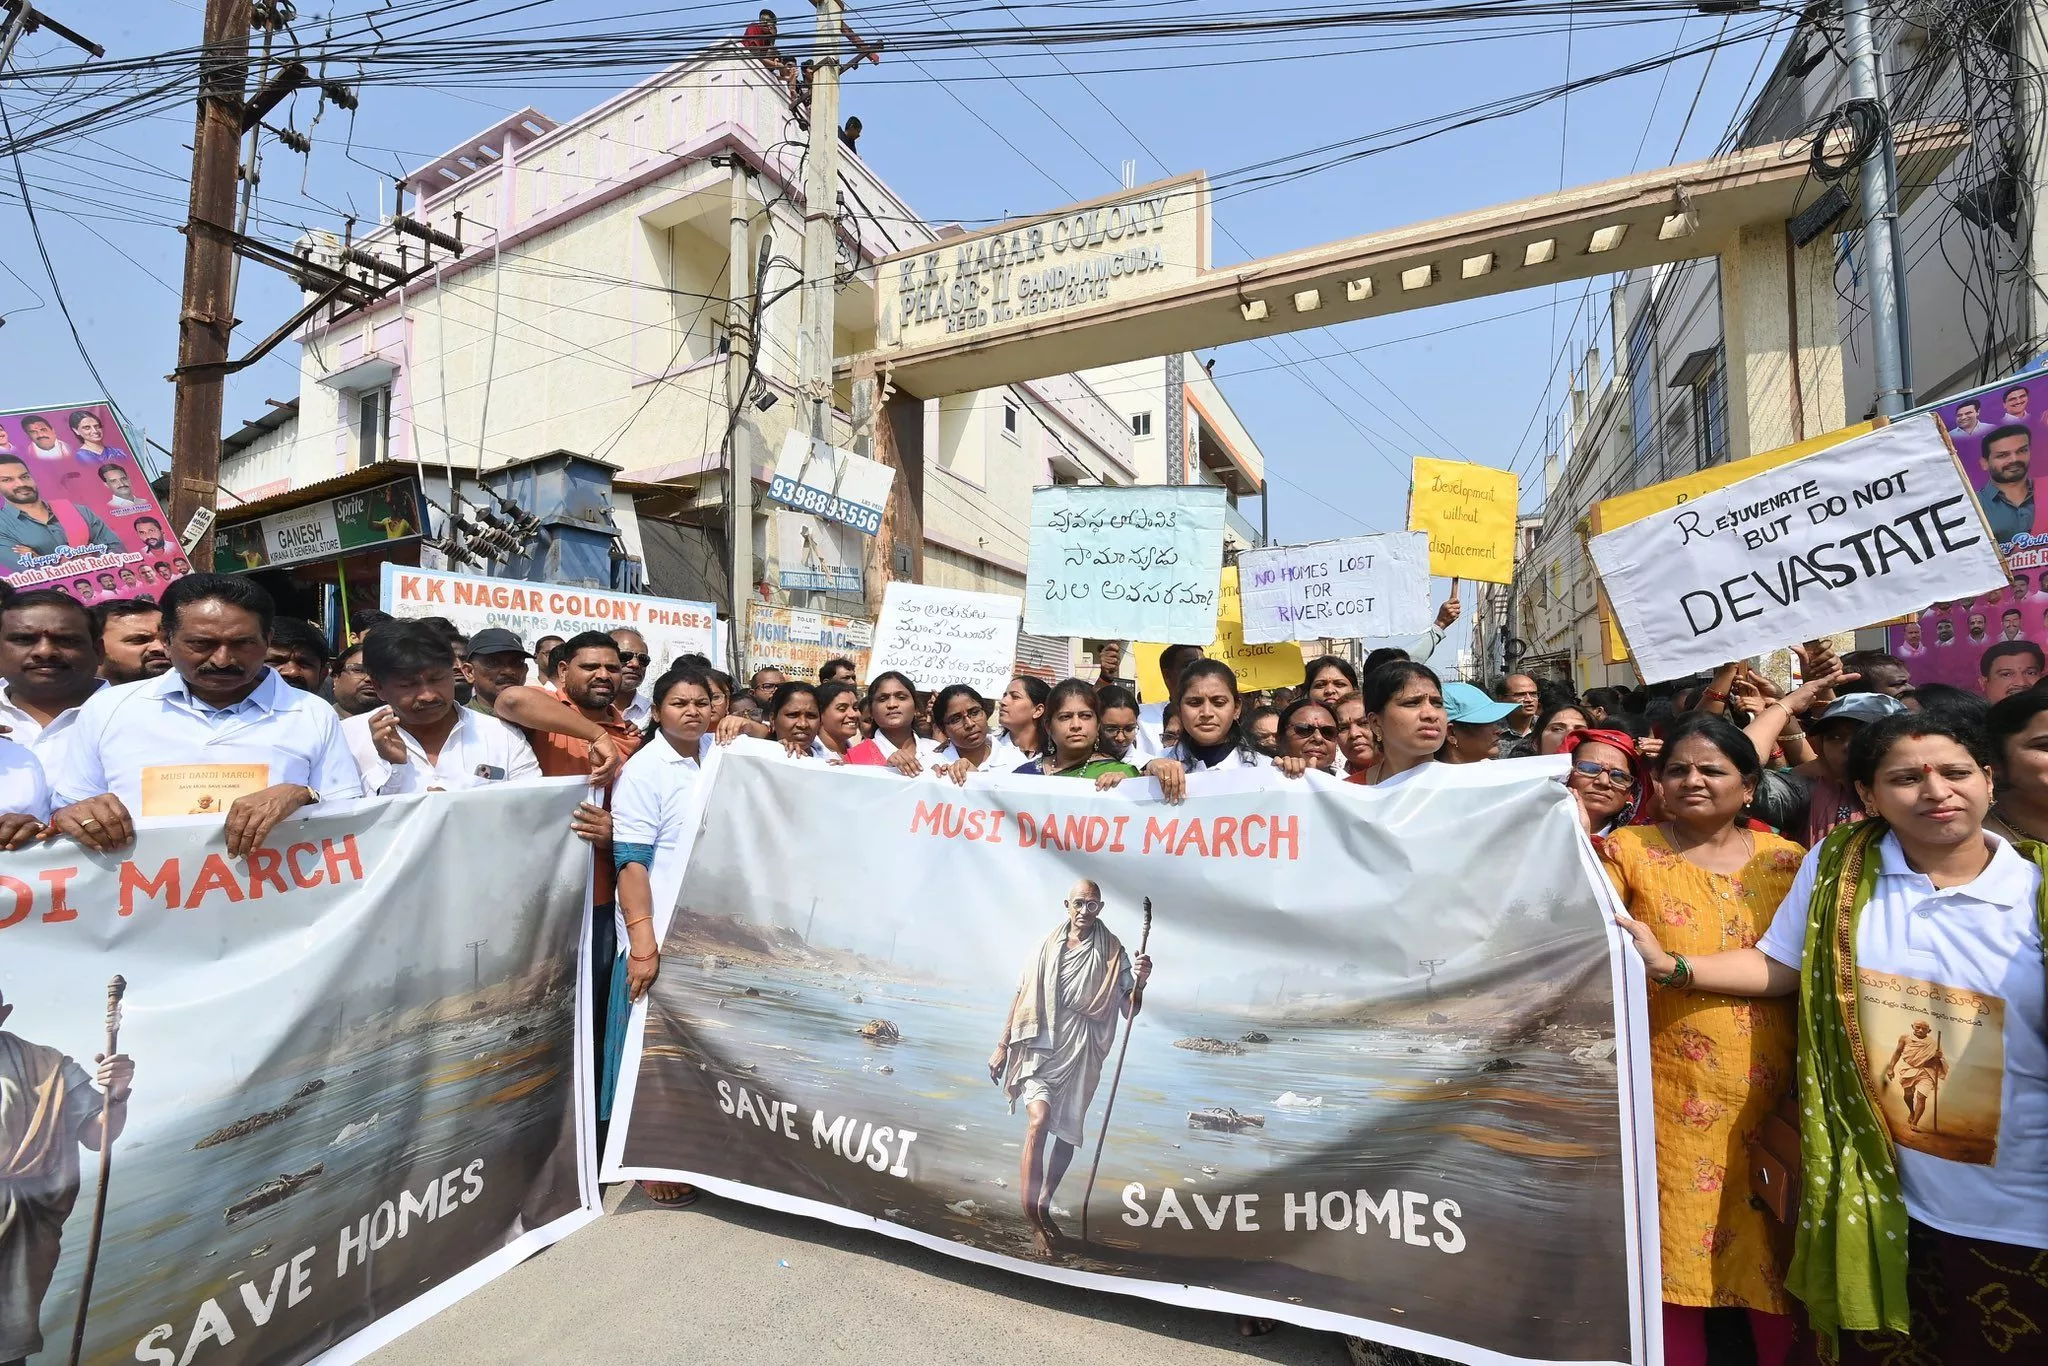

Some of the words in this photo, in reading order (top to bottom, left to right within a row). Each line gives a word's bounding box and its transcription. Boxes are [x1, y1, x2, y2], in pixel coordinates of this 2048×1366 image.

[955, 226, 1044, 280] NAGAR
[1052, 197, 1168, 251] COLONY
[1017, 243, 1164, 299] GANDHAMGUDA
[946, 309, 987, 333] REGD
[771, 479, 878, 531] 9398895556
[1431, 475, 1496, 504] Development
[337, 497, 364, 523] Sprite
[1443, 505, 1478, 523] without
[1673, 478, 1820, 545] REJUVENATE
[1743, 513, 1793, 553] BUT
[1807, 494, 1847, 526] DO
[1855, 469, 1910, 509] NOT
[270, 551, 290, 562] KIRANA
[295, 544, 319, 558] GENERAL
[320, 539, 339, 551] STORE
[278, 522, 324, 549] GANESH
[1429, 535, 1496, 560] displacement
[18, 553, 59, 568] Happy
[55, 543, 107, 558] Birthday
[45, 564, 87, 579] Karthik
[90, 555, 121, 570] Reddy
[1254, 568, 1276, 588] NO
[1281, 563, 1328, 582] HOMES
[1339, 555, 1374, 573] LOST
[1679, 493, 1982, 637] DEVASTATE
[453, 581, 544, 613] NAGAR
[549, 593, 642, 622] COLONY
[648, 608, 712, 630] PHASE-2
[1304, 583, 1332, 599] FOR
[1335, 597, 1374, 615] COST
[160, 773, 185, 781] MUSI
[189, 772, 218, 780] DANDI
[222, 771, 255, 779] MARCH
[909, 799, 1005, 843] MUSI
[1016, 811, 1129, 854] DANDI
[1142, 815, 1299, 860] MARCH
[118, 833, 363, 916] MARCH
[717, 1079, 800, 1141] SAVE
[812, 1110, 917, 1178] MUSI
[1121, 1181, 1260, 1232] SAVE
[1284, 1189, 1466, 1254] HOMES
[134, 1245, 317, 1366] SAVE
[337, 1158, 484, 1278] HOMES
